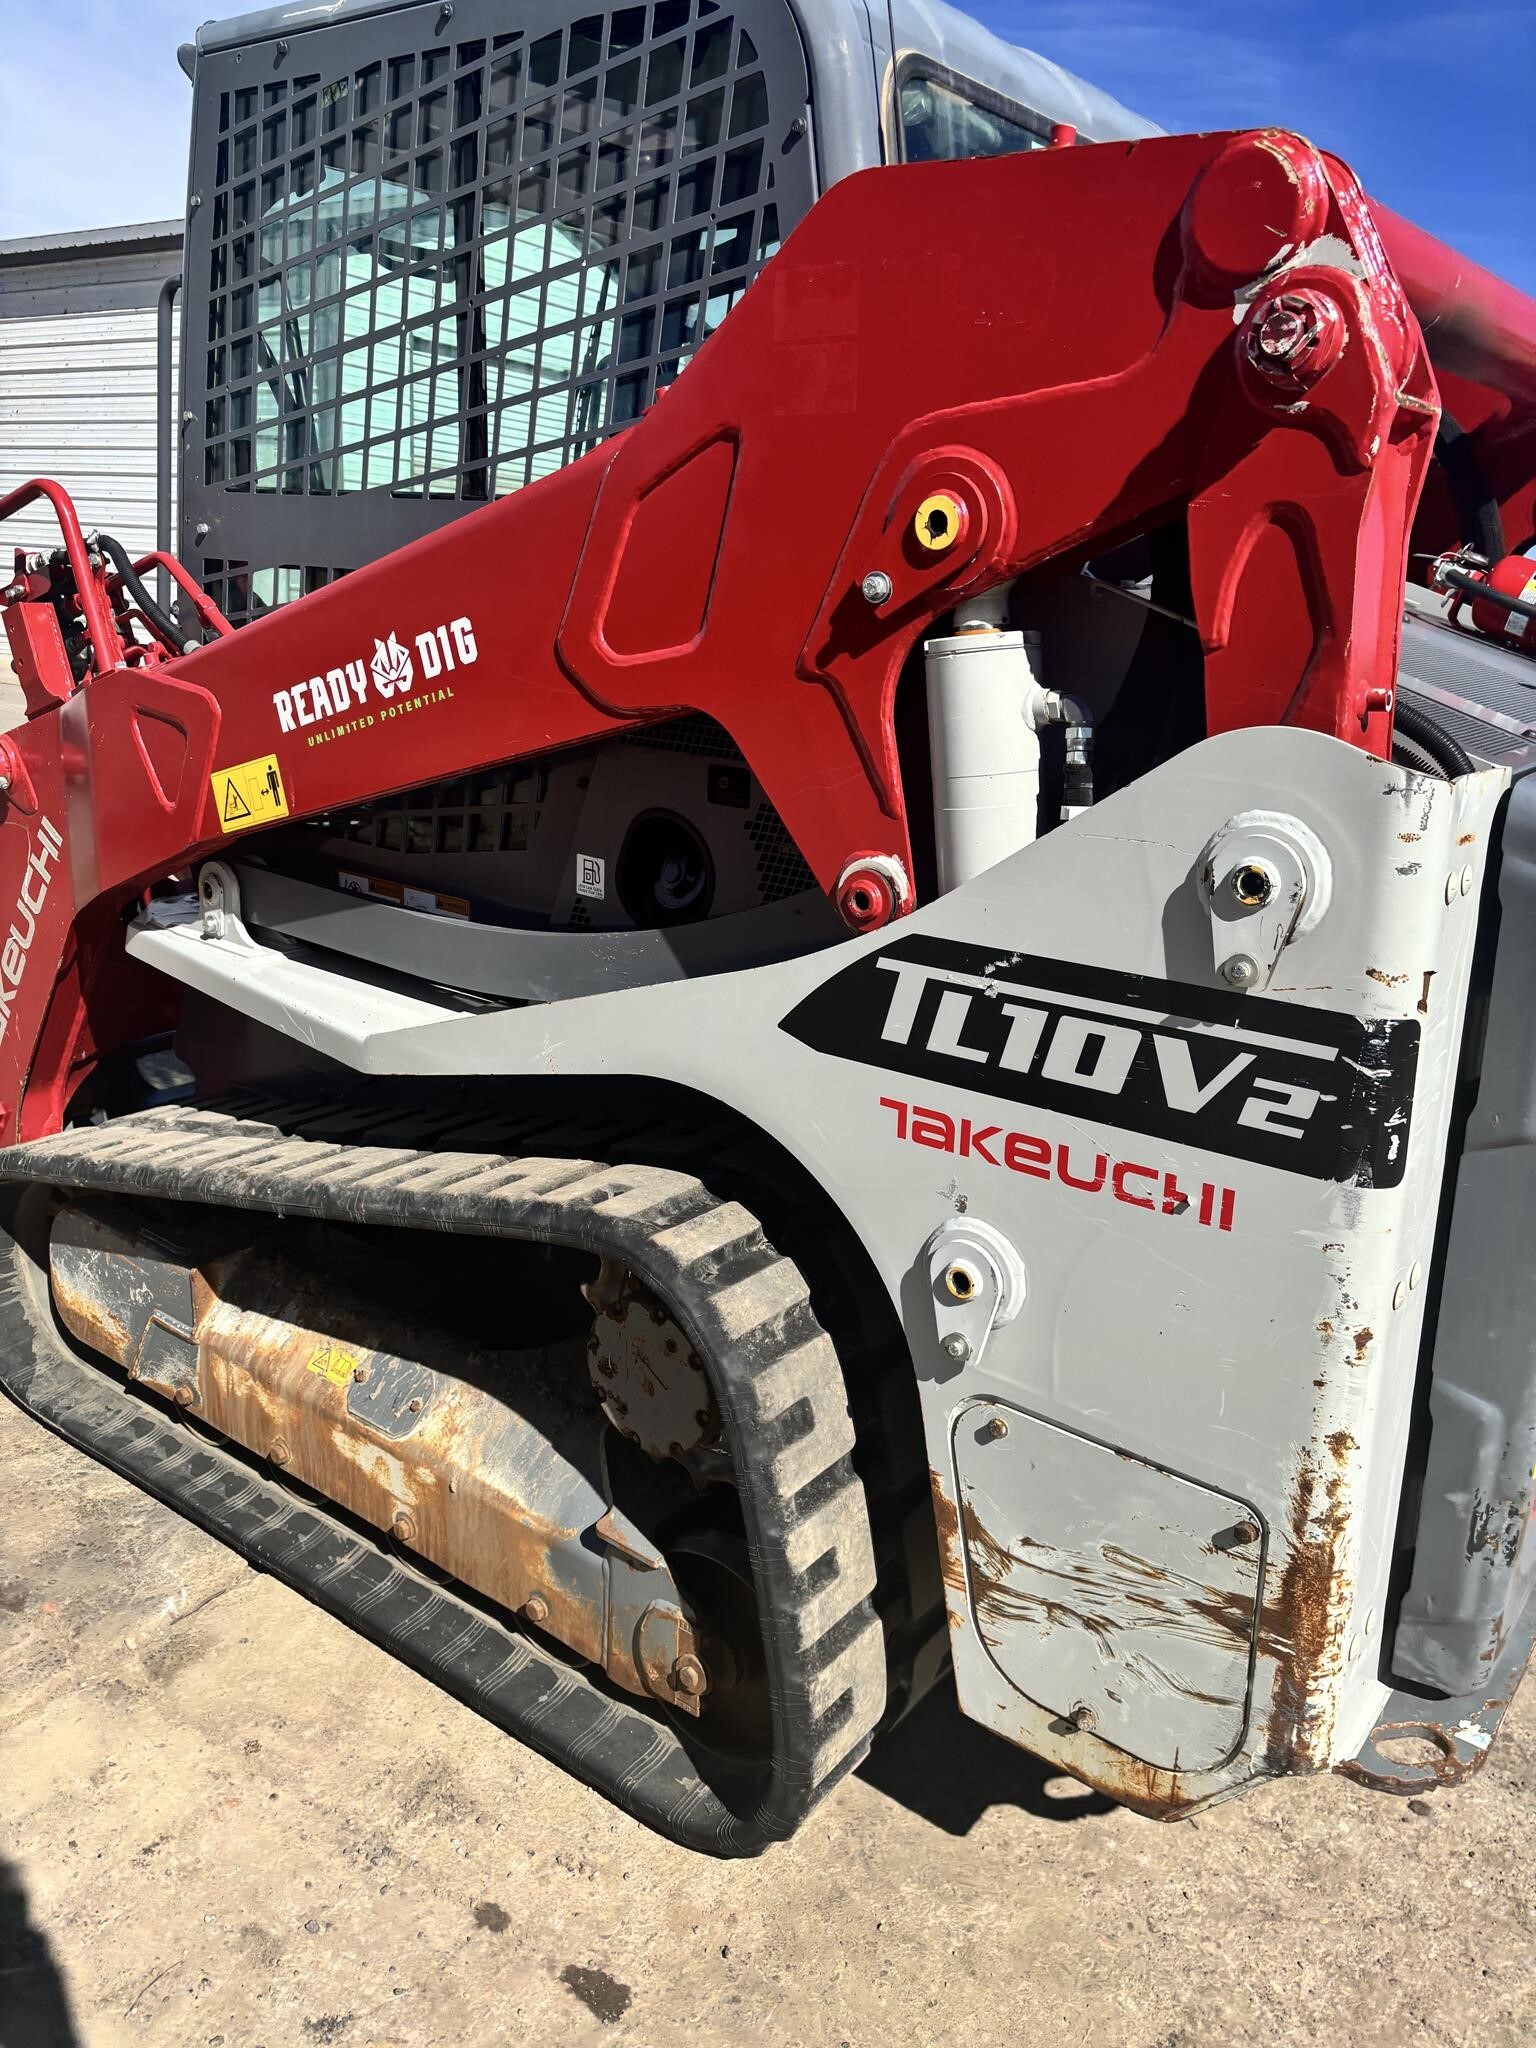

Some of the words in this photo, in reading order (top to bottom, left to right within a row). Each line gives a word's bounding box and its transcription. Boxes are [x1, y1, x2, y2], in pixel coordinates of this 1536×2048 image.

[272, 658, 368, 733] READY
[307, 714, 375, 747] UNLIMITED
[379, 686, 455, 722] POTENTIAL
